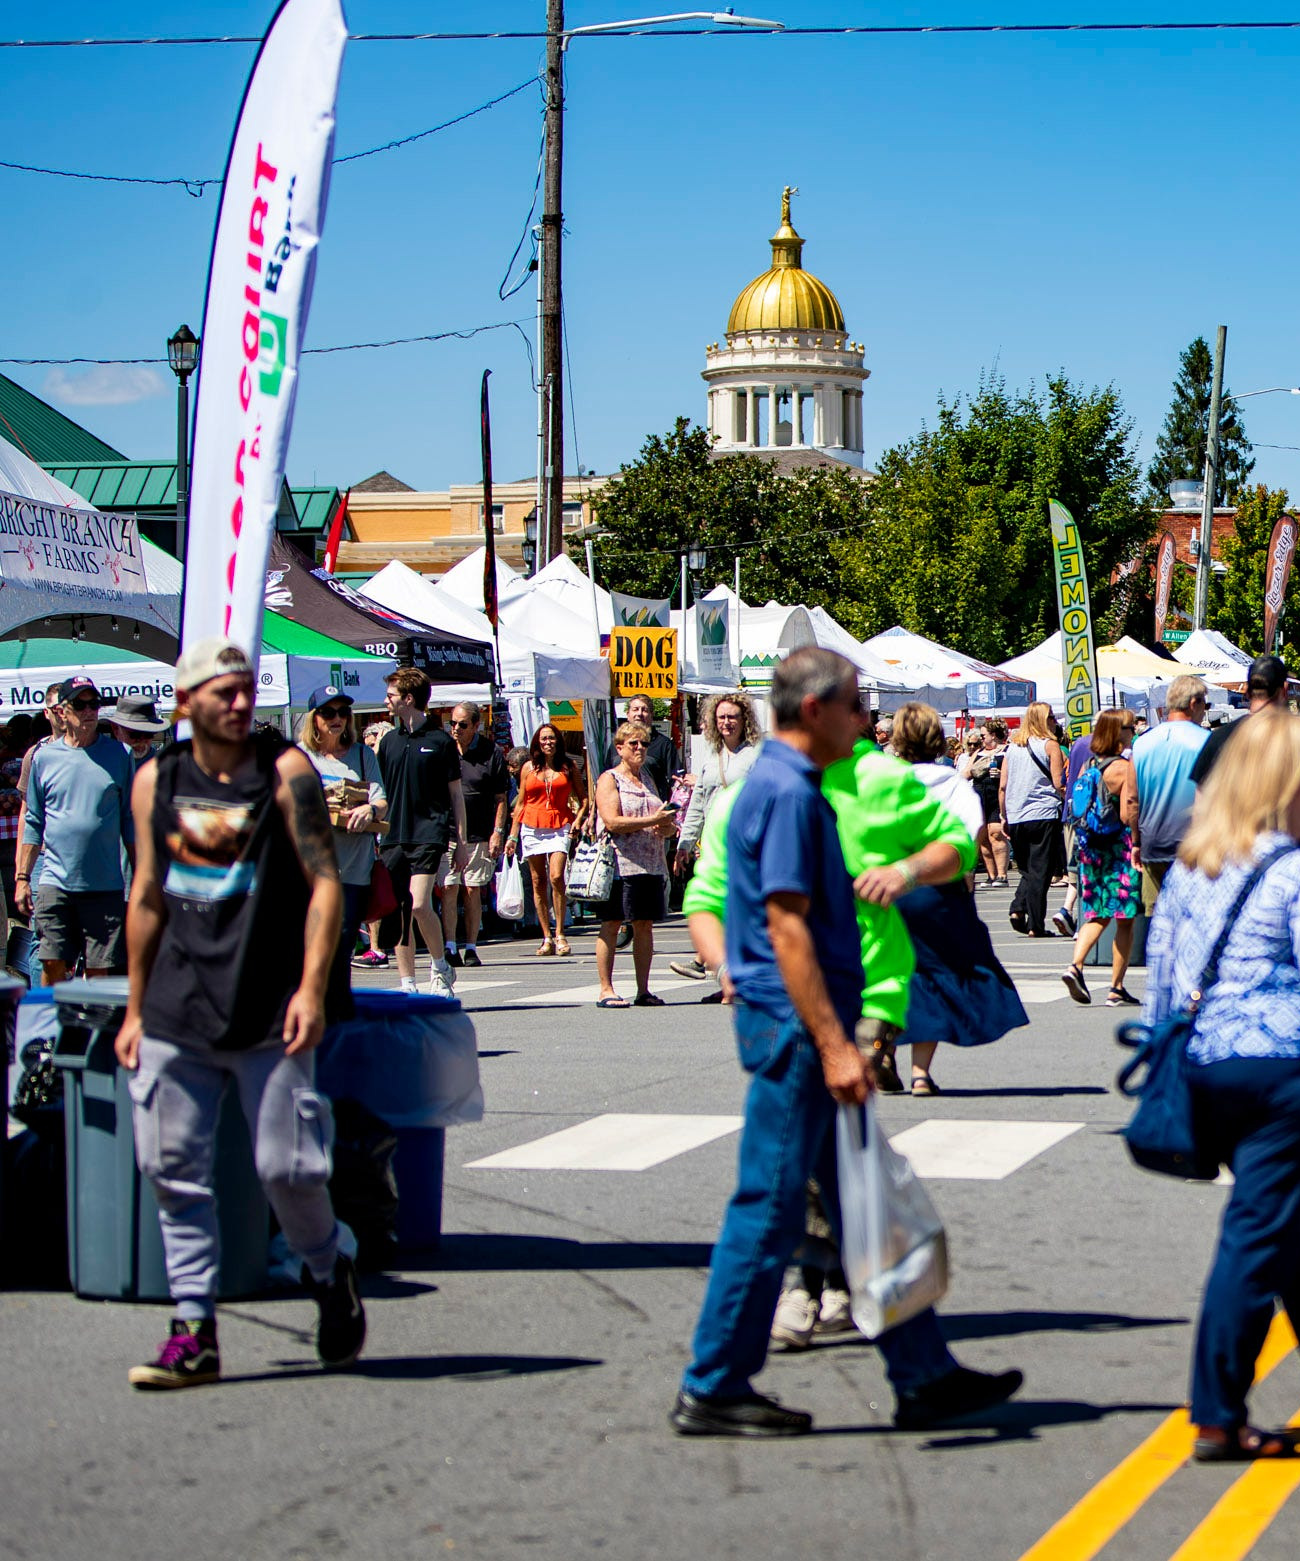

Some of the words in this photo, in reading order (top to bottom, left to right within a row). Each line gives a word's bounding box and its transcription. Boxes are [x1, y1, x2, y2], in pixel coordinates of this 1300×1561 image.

[60, 511, 136, 558] BRANCH
[1275, 525, 1293, 563] Edge
[41, 542, 100, 575] FARMS
[1171, 632, 1187, 640] Allen
[365, 643, 399, 657] BBQ
[615, 635, 673, 669] DOG
[344, 671, 360, 687] Bank
[614, 672, 674, 690] TREATS
